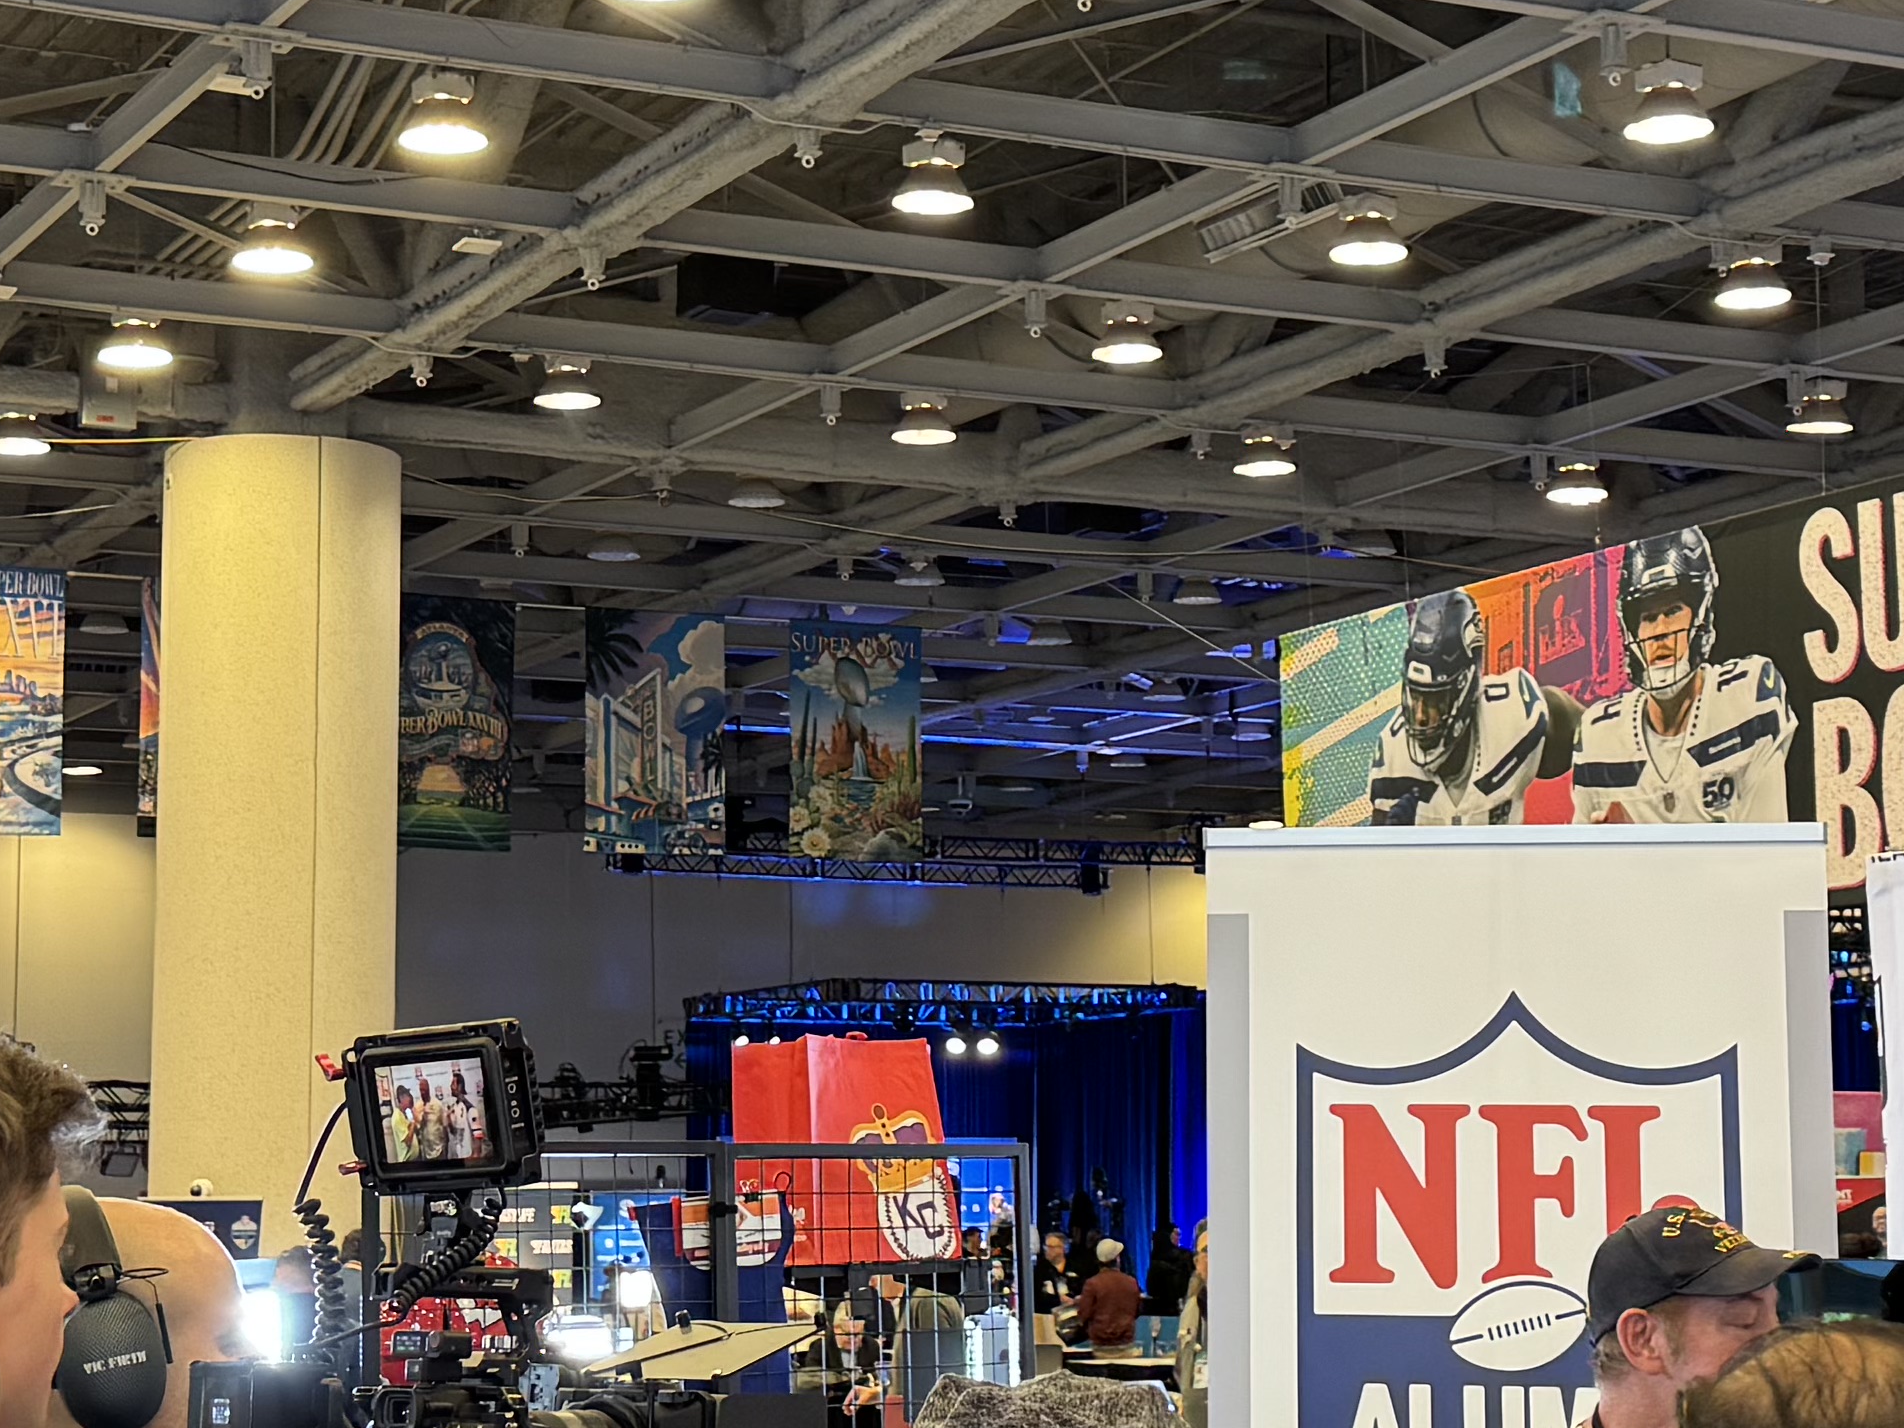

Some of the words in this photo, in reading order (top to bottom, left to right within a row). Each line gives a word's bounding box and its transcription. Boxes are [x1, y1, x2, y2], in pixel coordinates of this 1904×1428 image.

[26, 571, 65, 598] BOWL
[790, 631, 851, 654] SUPER
[1328, 1103, 1700, 1290] NFL
[892, 1193, 945, 1240] KC
